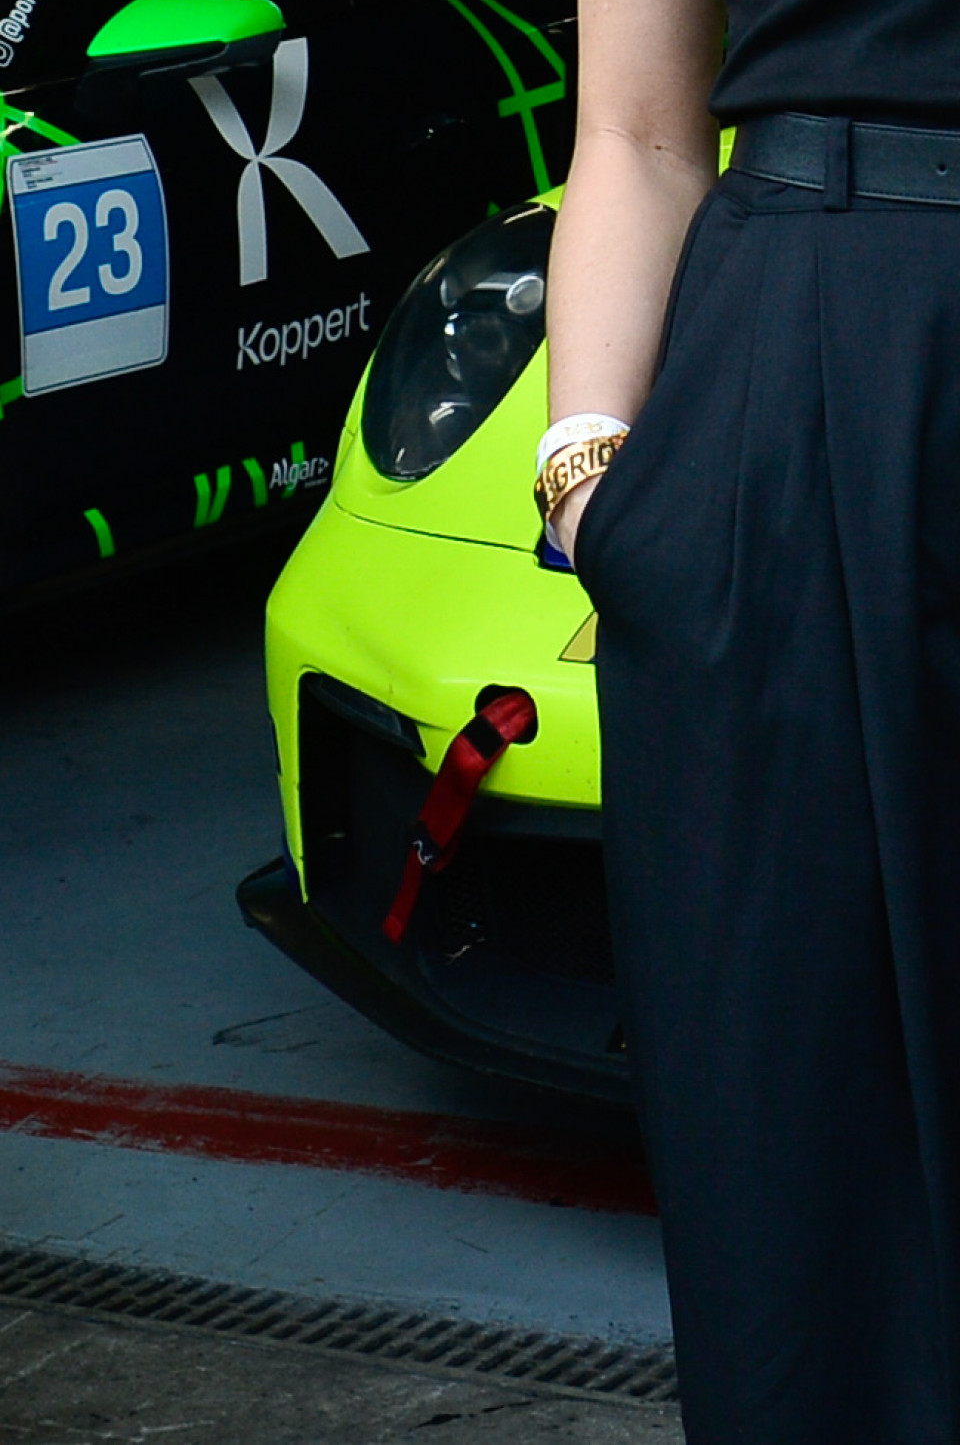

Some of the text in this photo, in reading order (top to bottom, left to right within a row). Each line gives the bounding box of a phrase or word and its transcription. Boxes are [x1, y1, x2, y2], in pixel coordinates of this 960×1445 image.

[43, 189, 142, 311] 23
[237, 292, 371, 370] Koppert
[269, 457, 318, 491] Algar
